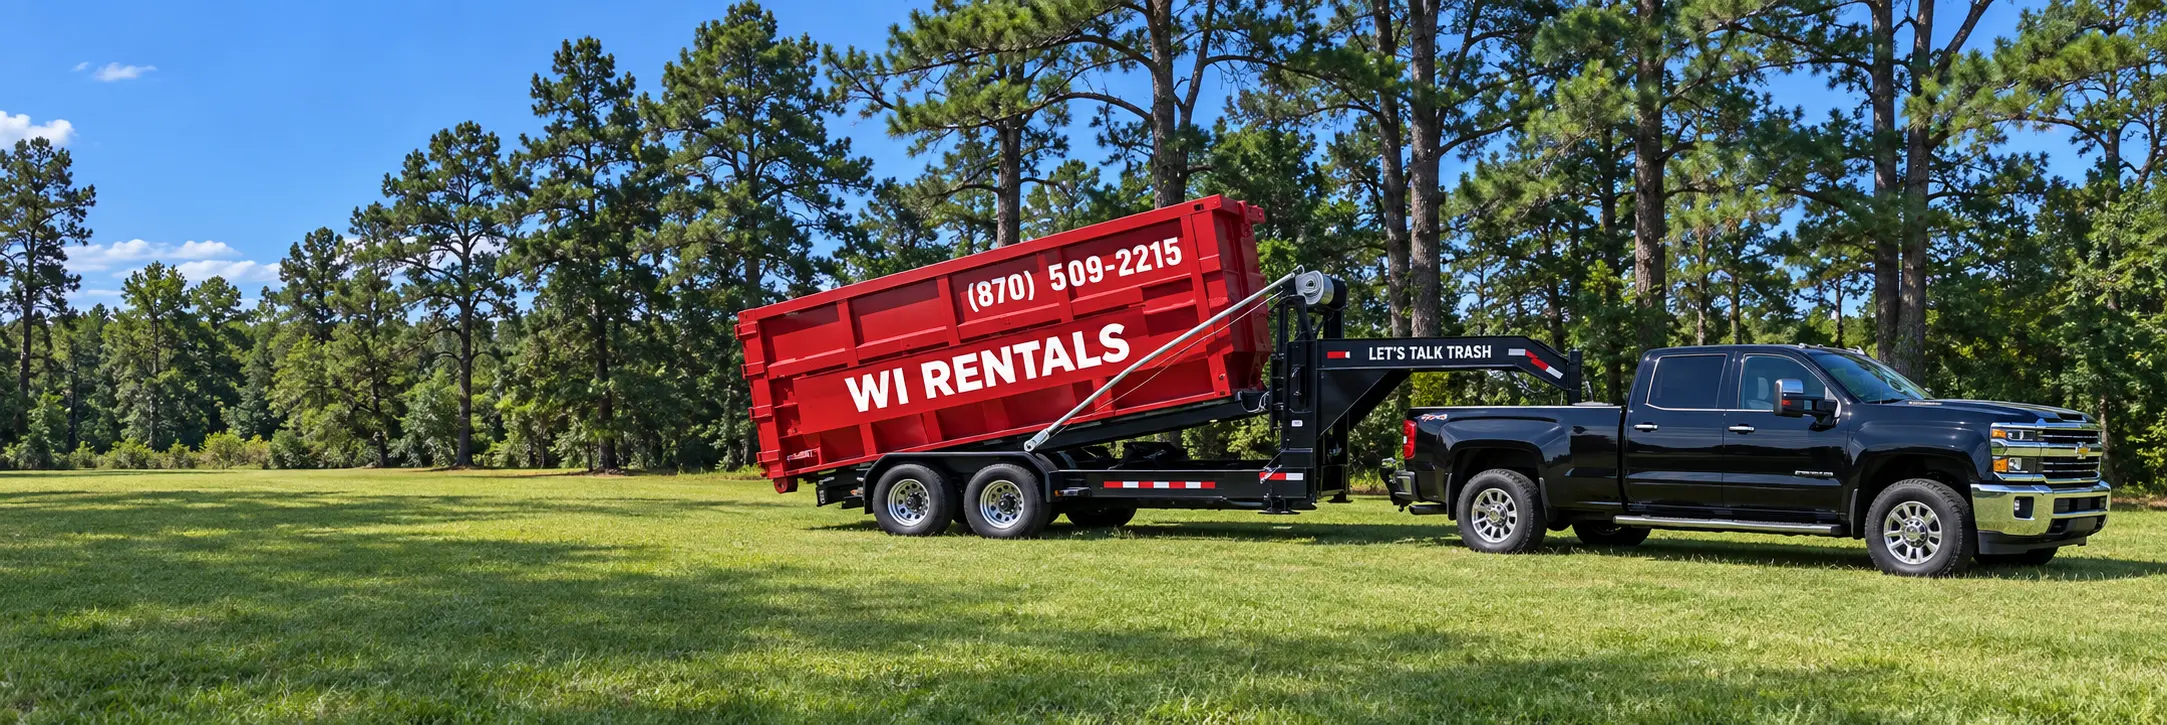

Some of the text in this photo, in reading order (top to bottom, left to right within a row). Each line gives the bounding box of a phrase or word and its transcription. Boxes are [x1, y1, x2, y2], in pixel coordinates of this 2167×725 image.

[967, 236, 1183, 313] (870) 509-2215
[845, 323, 1130, 413] WI RENTALS
[1368, 344, 1492, 361] LET'S TALK TRASH
